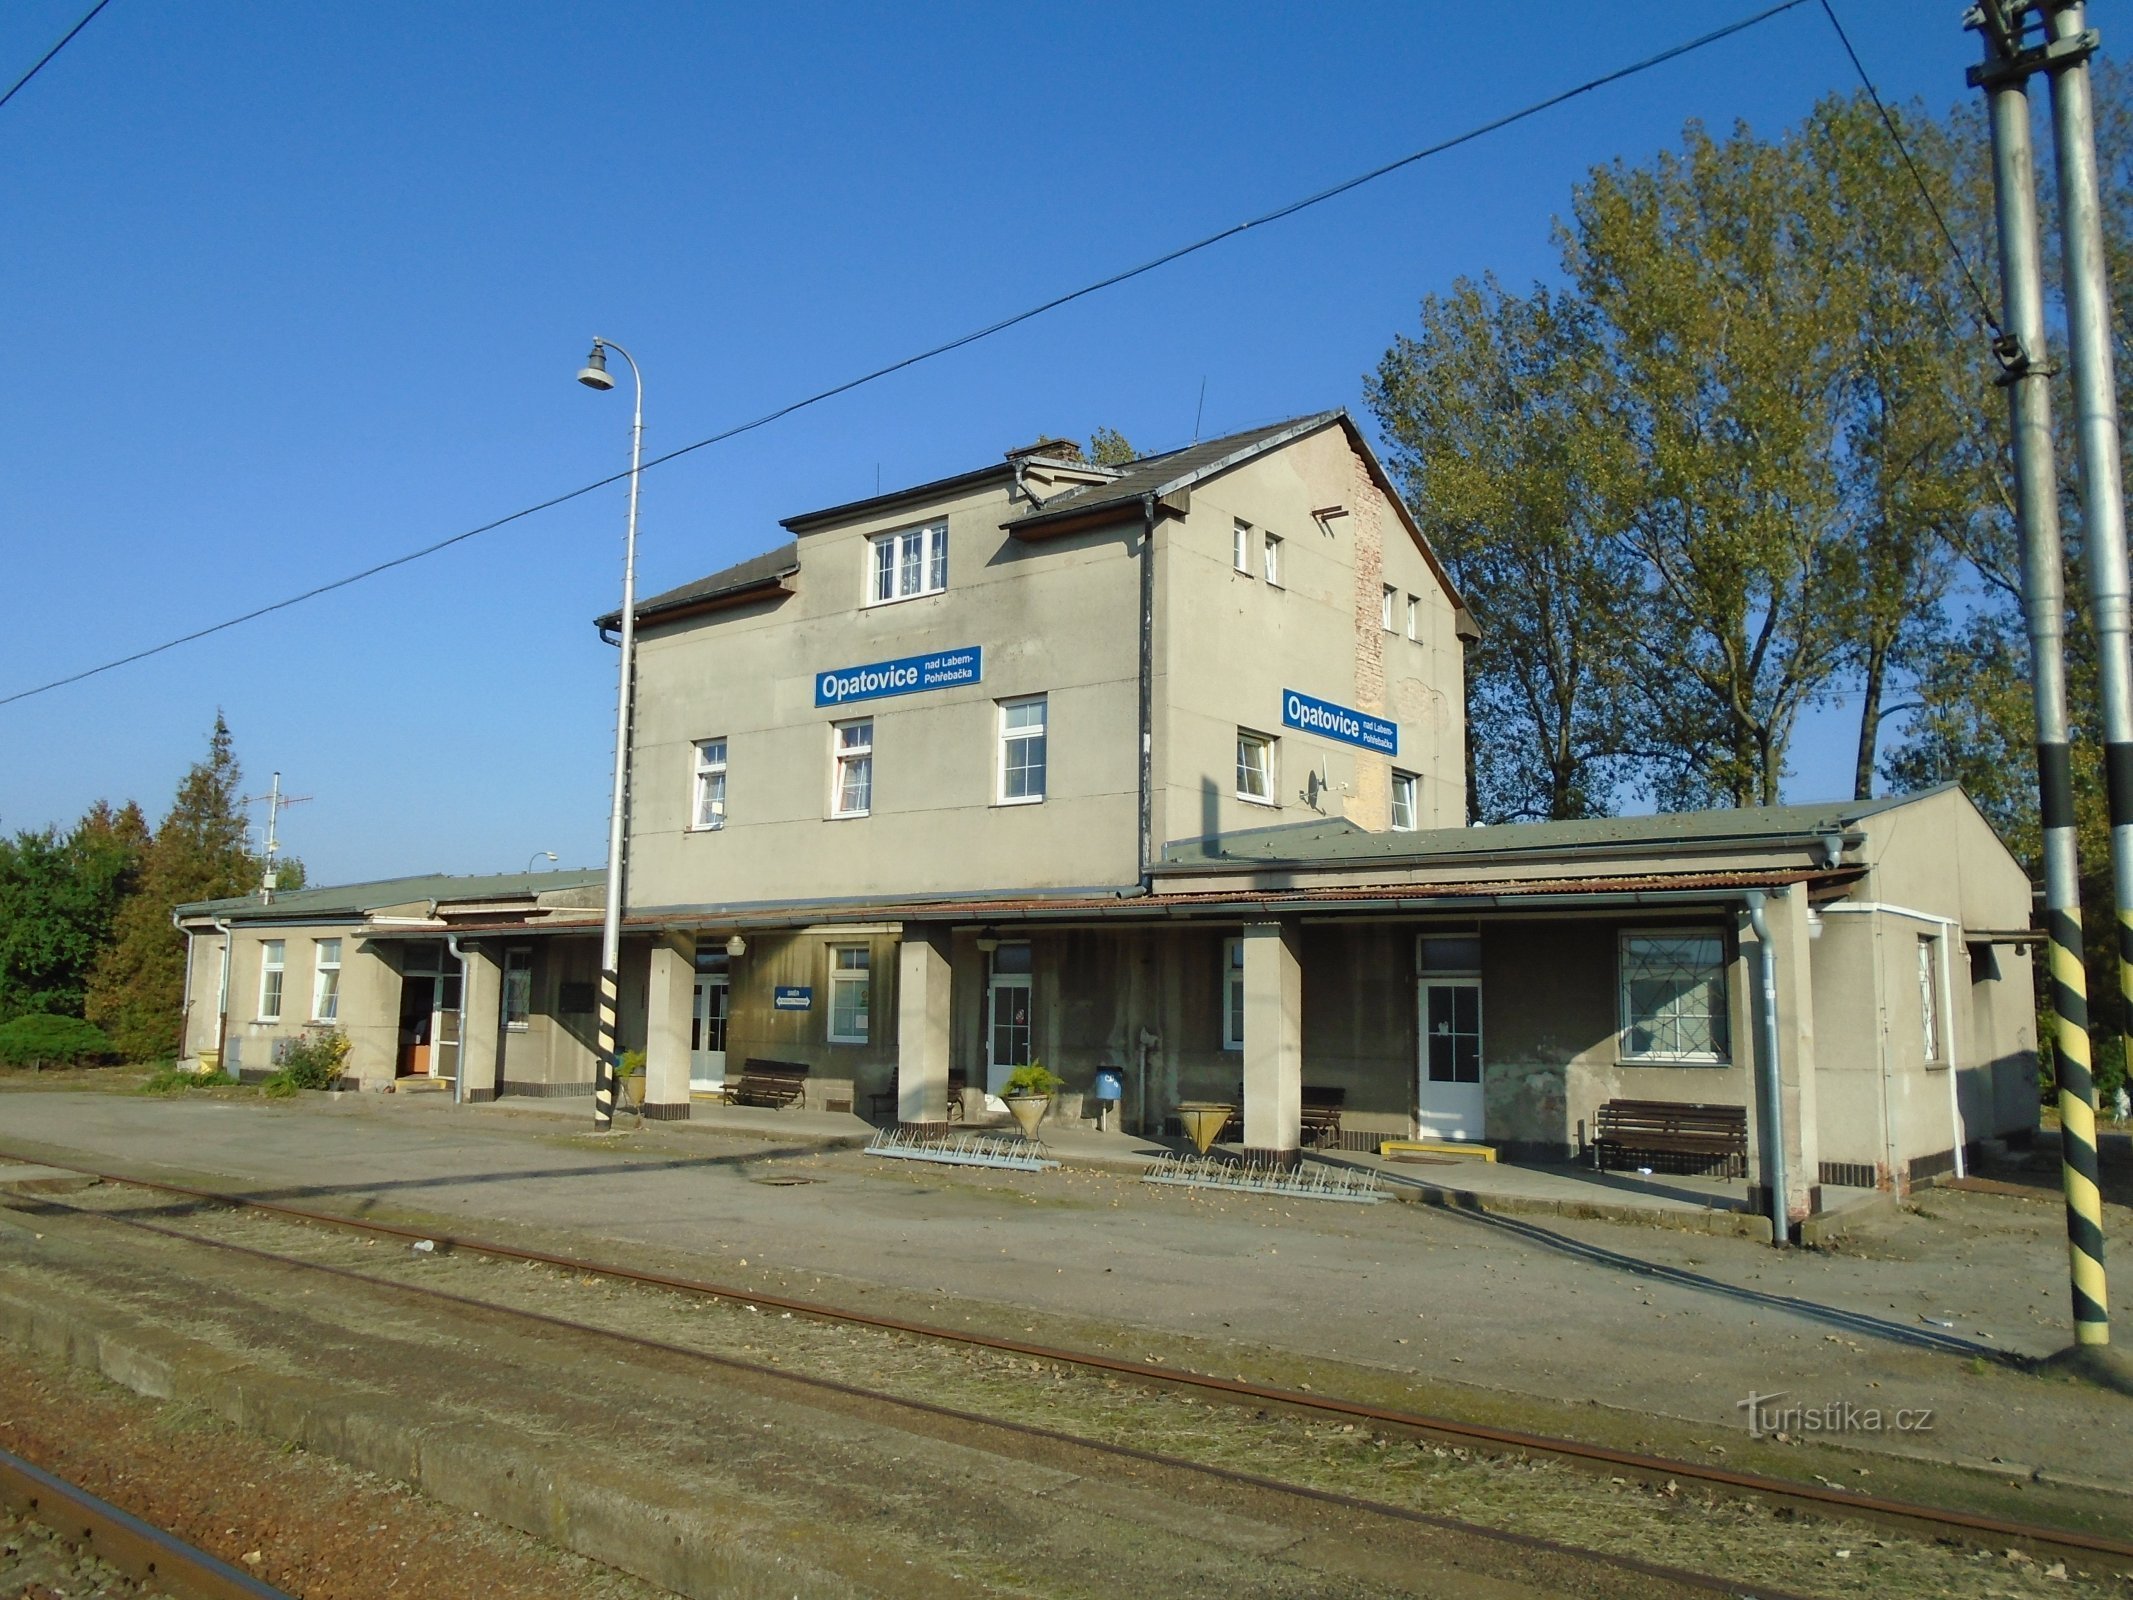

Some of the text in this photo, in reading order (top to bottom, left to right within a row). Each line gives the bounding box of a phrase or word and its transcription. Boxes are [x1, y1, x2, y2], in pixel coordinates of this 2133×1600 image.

[925, 655, 973, 669] nad Labem-
[822, 665, 918, 701] Opatovice
[924, 668, 973, 684] Pohřebačka
[1288, 696, 1359, 737] Opatovice
[1363, 721, 1393, 734] nad Labem-
